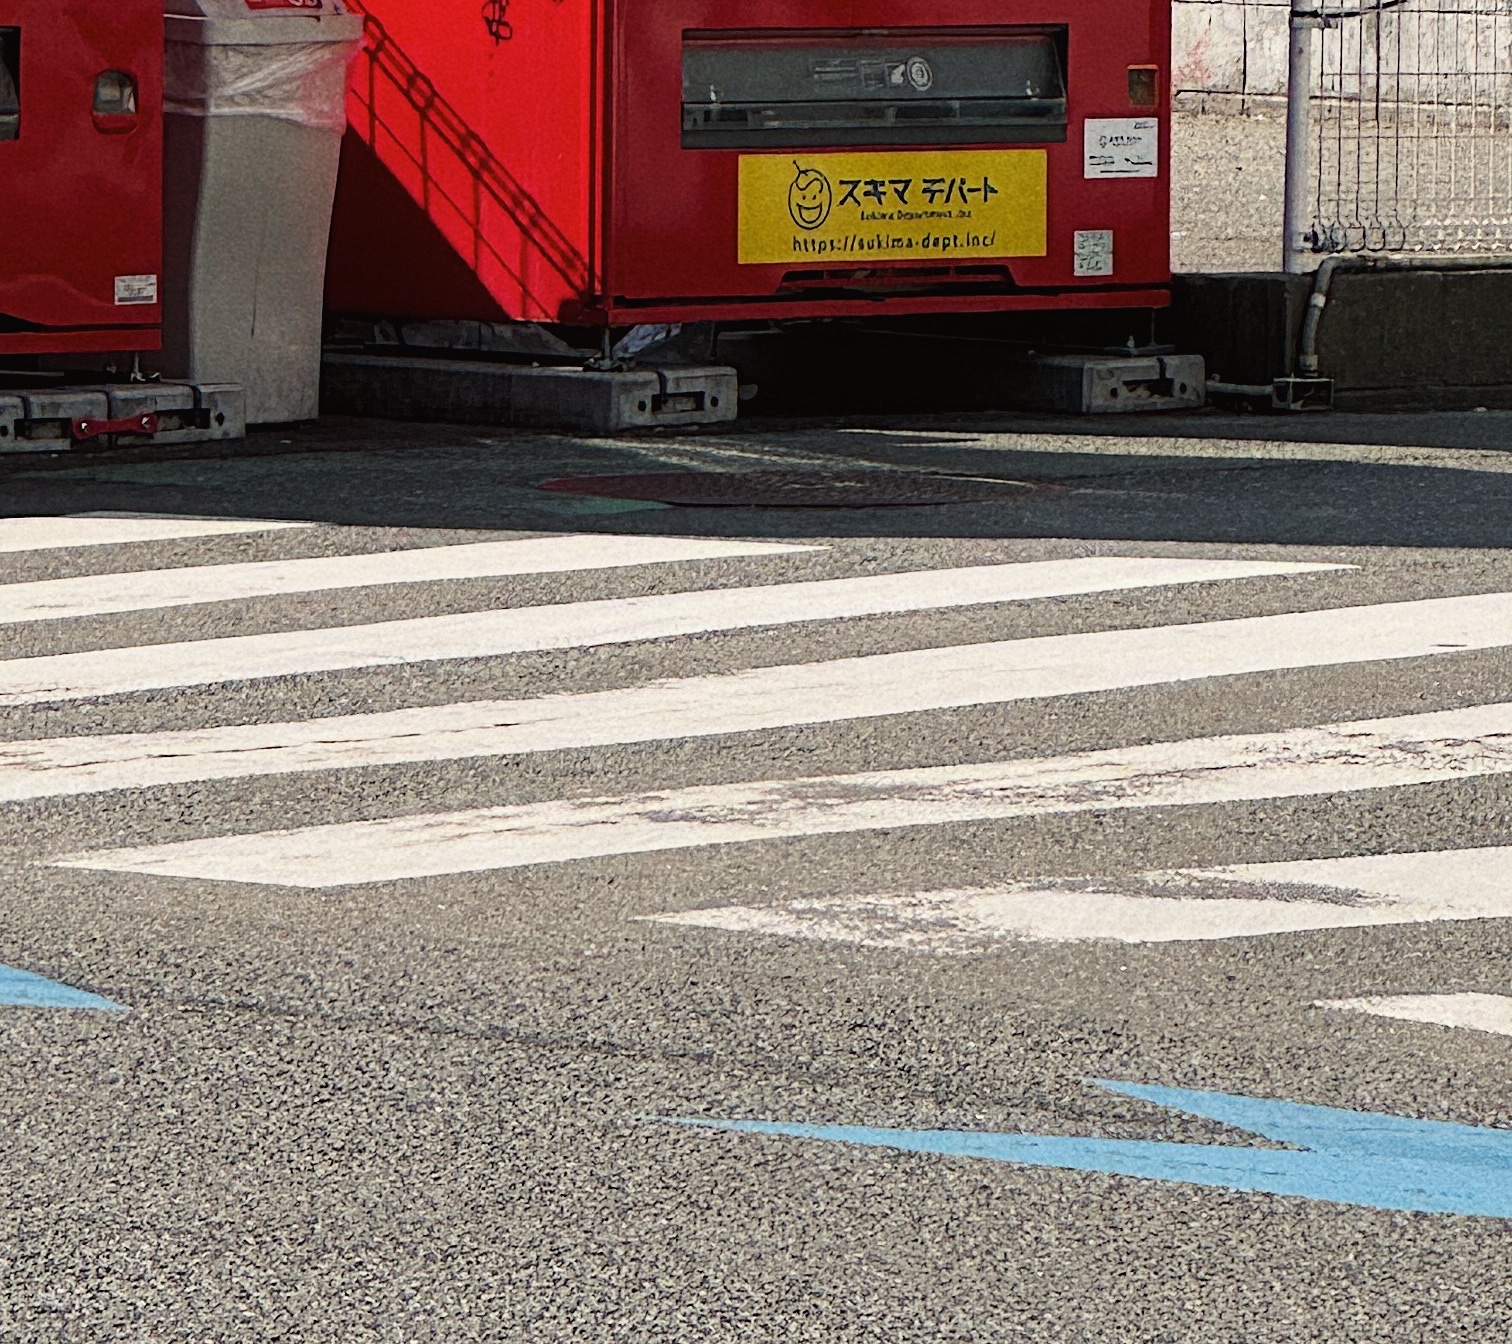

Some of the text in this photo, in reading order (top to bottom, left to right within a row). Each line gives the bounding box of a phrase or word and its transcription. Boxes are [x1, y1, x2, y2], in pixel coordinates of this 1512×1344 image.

[838, 176, 999, 207] スキマ デパート
